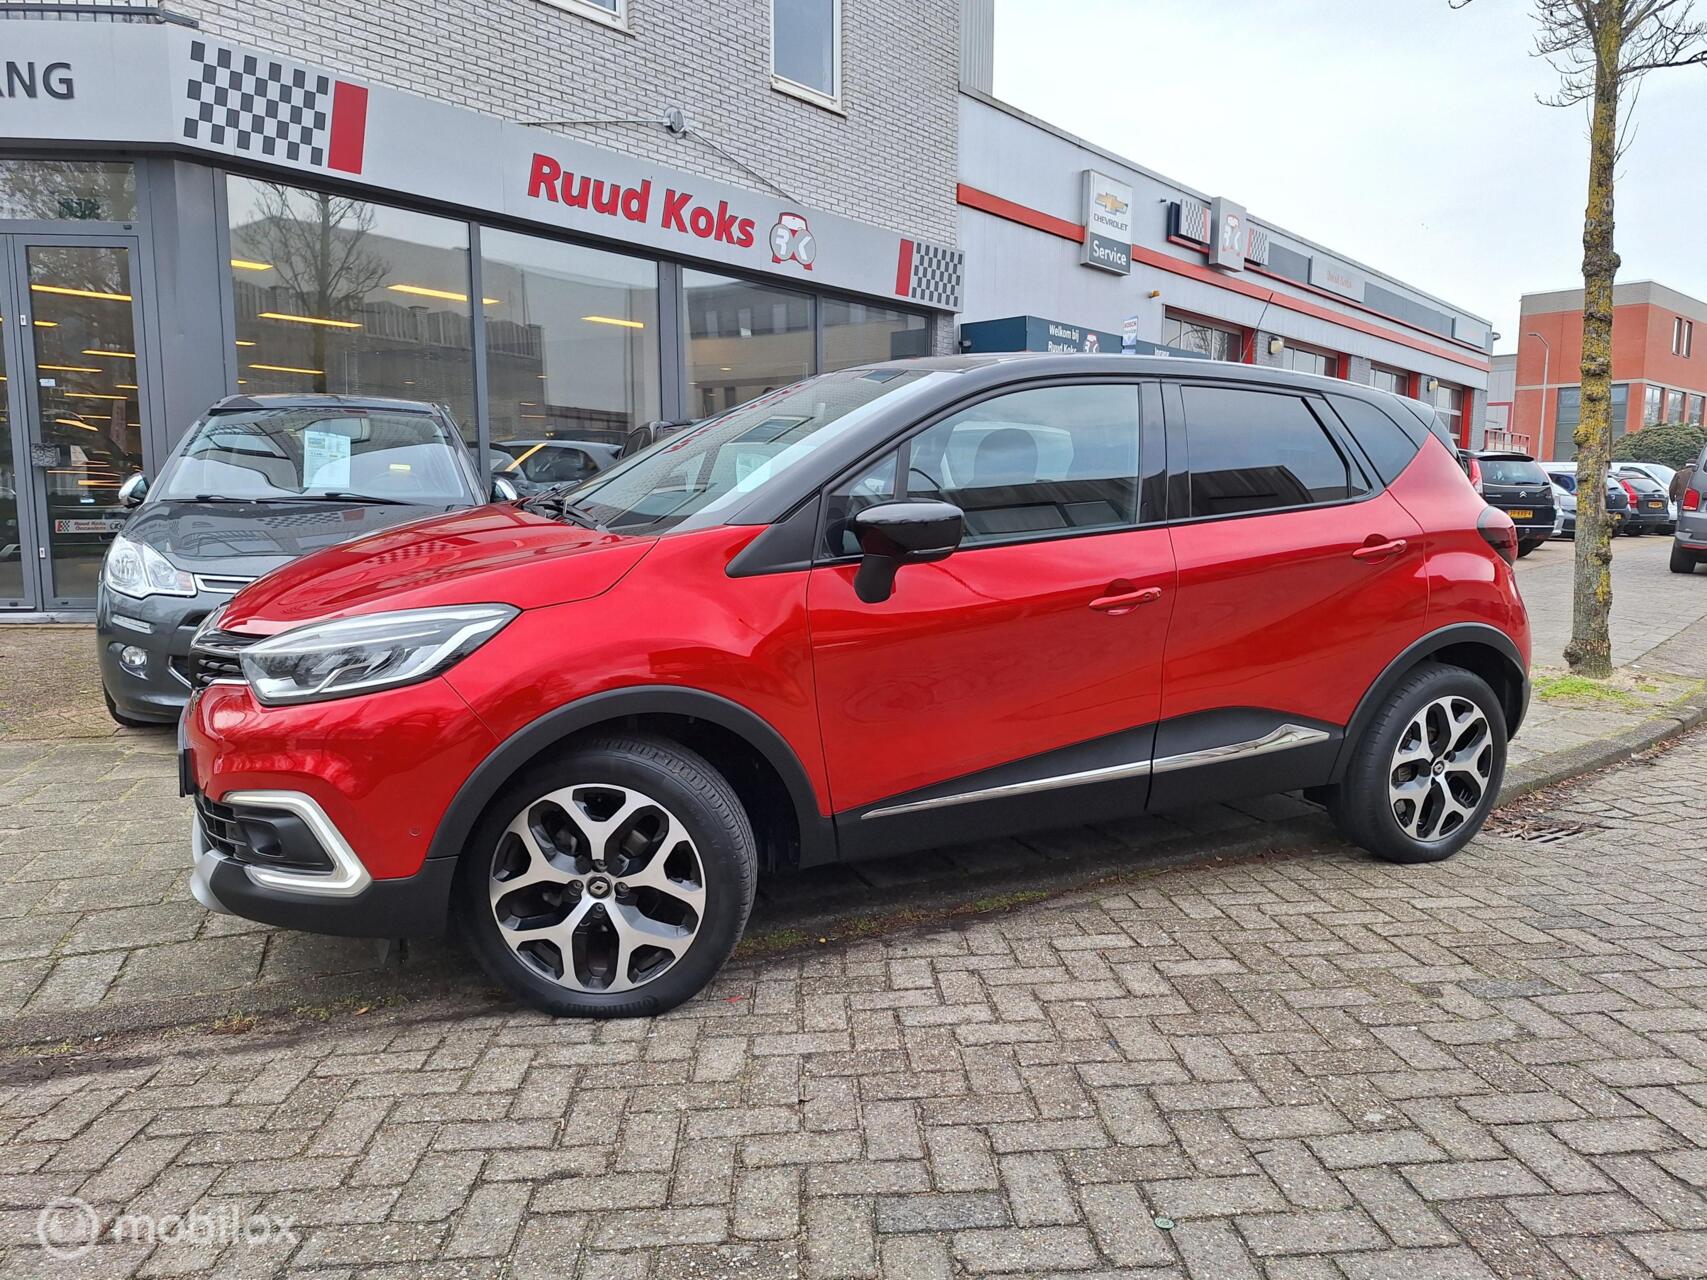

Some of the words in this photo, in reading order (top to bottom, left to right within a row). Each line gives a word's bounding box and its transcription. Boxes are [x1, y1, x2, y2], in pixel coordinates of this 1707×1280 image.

[0, 61, 75, 100] NG
[527, 152, 652, 223] Ruud
[661, 188, 756, 248] Koks
[1093, 213, 1128, 232] CHEVROLET
[1092, 240, 1127, 266] Service
[1049, 324, 1071, 339] Welkom
[1071, 328, 1080, 343] bij
